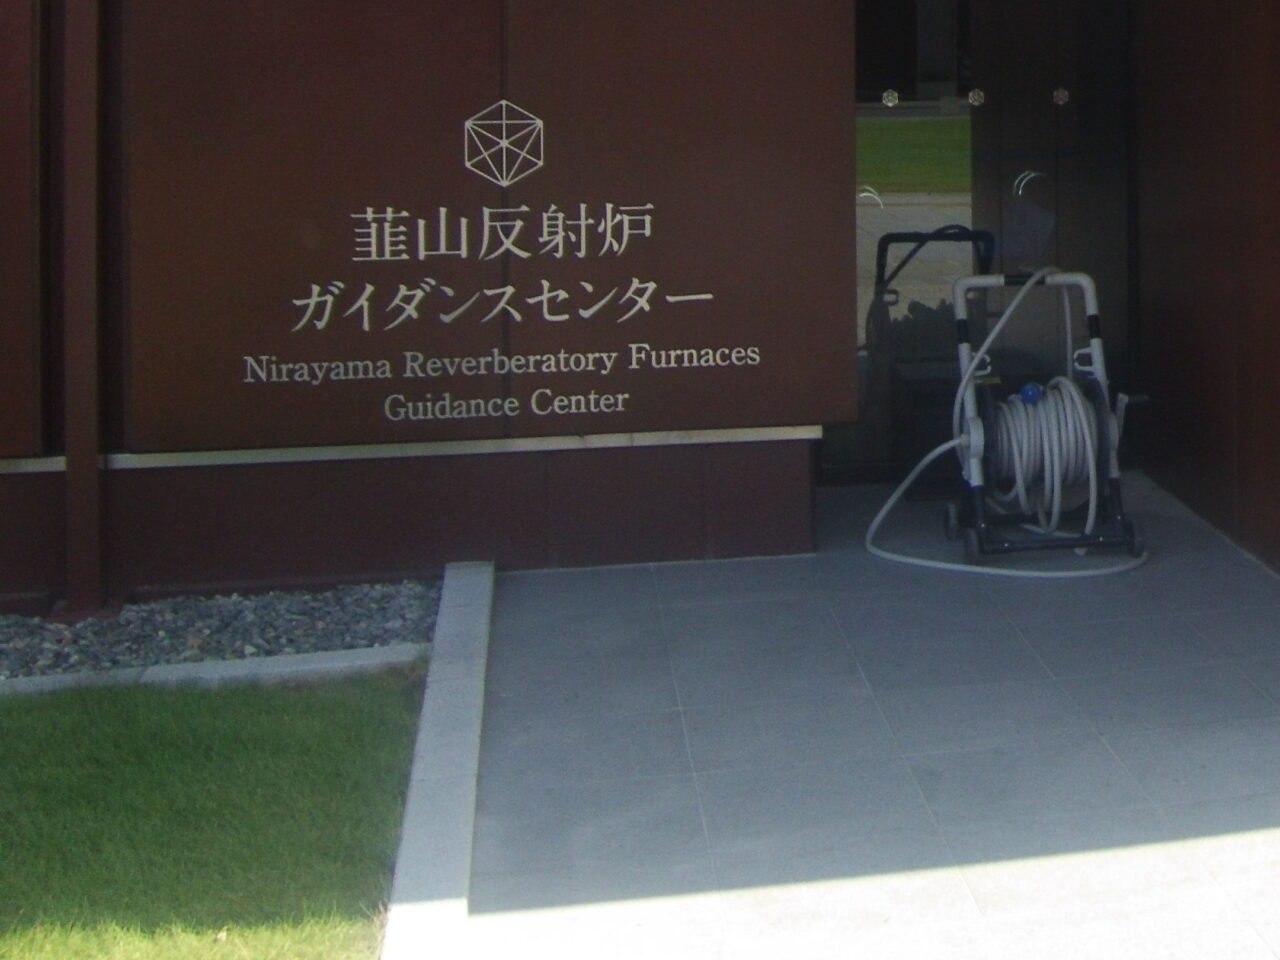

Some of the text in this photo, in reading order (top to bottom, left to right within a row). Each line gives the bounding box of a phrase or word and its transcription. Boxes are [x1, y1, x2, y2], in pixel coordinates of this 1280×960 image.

[350, 202, 655, 262] 韮山反射炉
[289, 276, 714, 333] ガイダンスセンター
[243, 342, 761, 386] Nirayama Reverberatory Furnaces
[384, 389, 630, 422] Guidance Center
